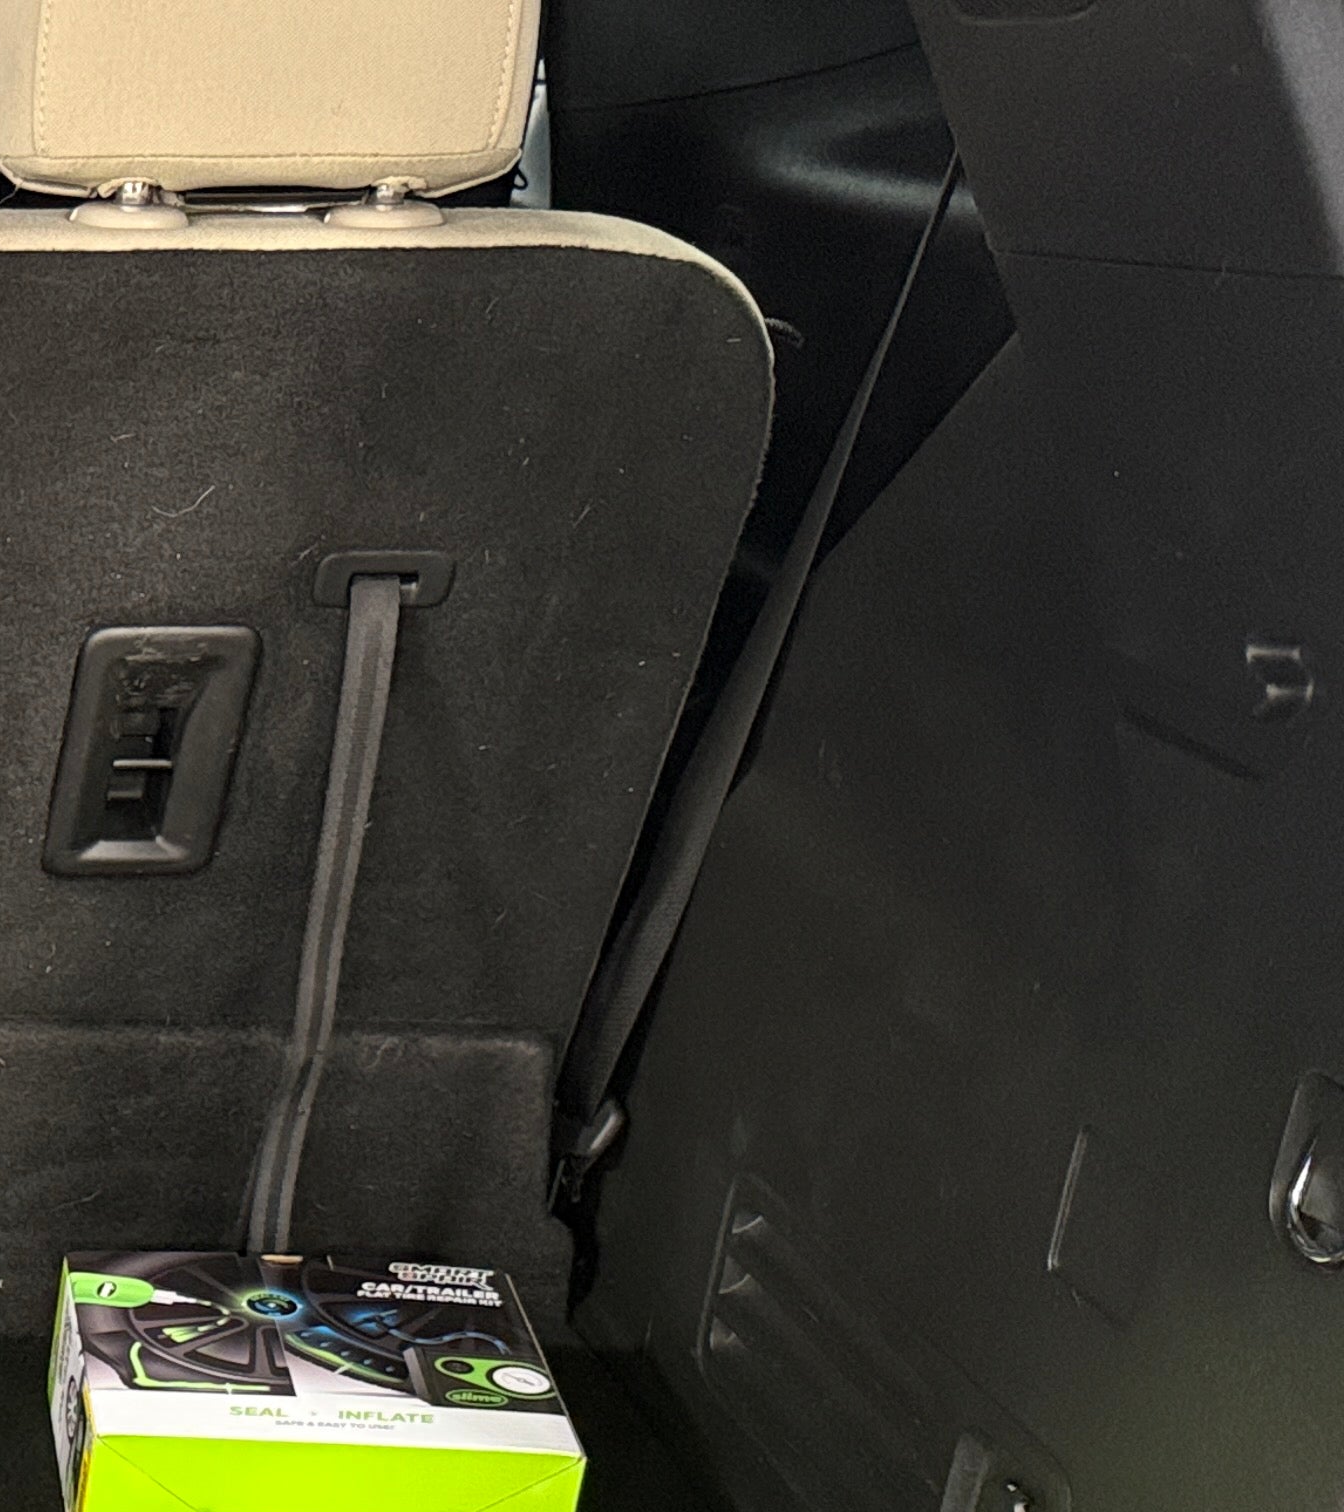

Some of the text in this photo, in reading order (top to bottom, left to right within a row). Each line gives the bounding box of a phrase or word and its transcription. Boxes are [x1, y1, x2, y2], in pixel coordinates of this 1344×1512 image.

[357, 1290, 503, 1307] FLAT TIRE REPAIR KIT
[361, 1281, 499, 1301] CAR/TRAILER
[229, 1406, 434, 1424] SEAL INFLATE
